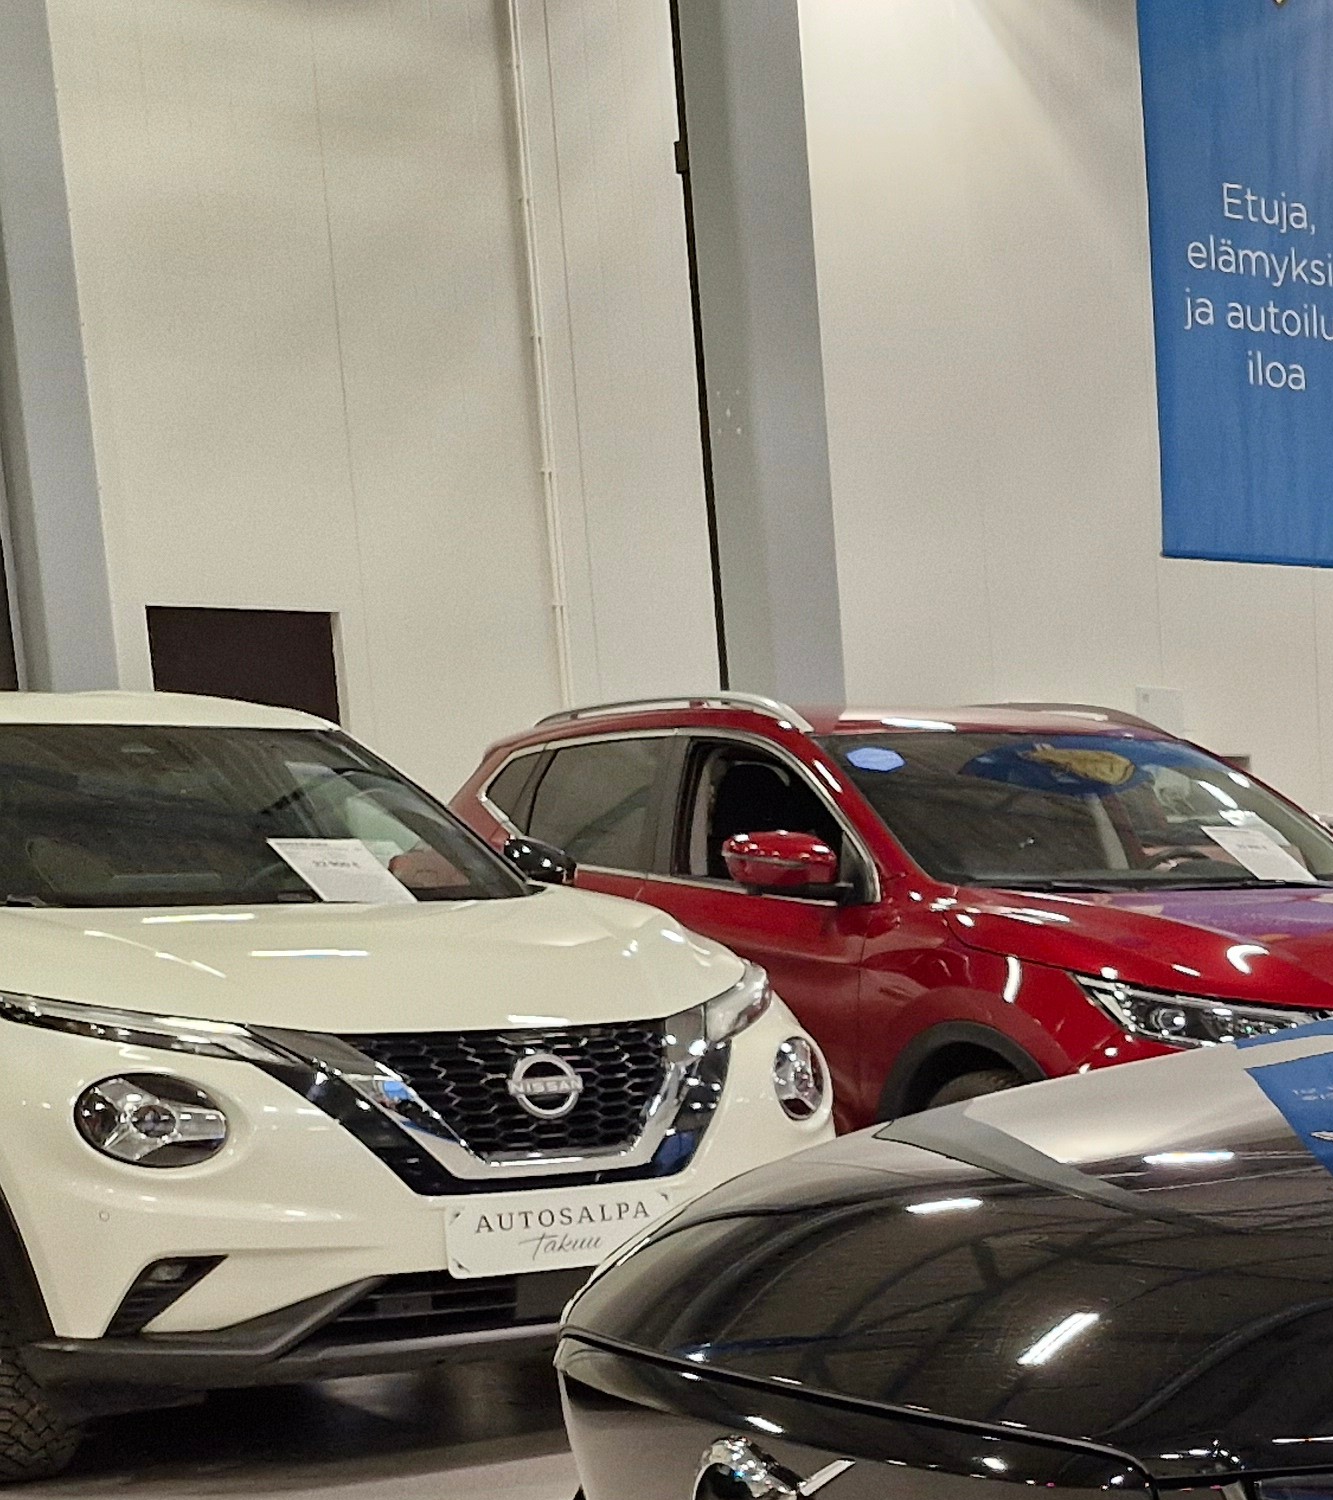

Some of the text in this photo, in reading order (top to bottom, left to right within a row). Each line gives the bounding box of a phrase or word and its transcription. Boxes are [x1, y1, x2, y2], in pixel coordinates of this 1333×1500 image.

[1222, 182, 1317, 236] Etuja,
[1184, 287, 1215, 331] ja
[1248, 350, 1307, 391] iloa
[508, 1076, 583, 1096] NISSAN
[475, 1200, 651, 1234] AUTOSALPA
[518, 1233, 602, 1261] Takuu
